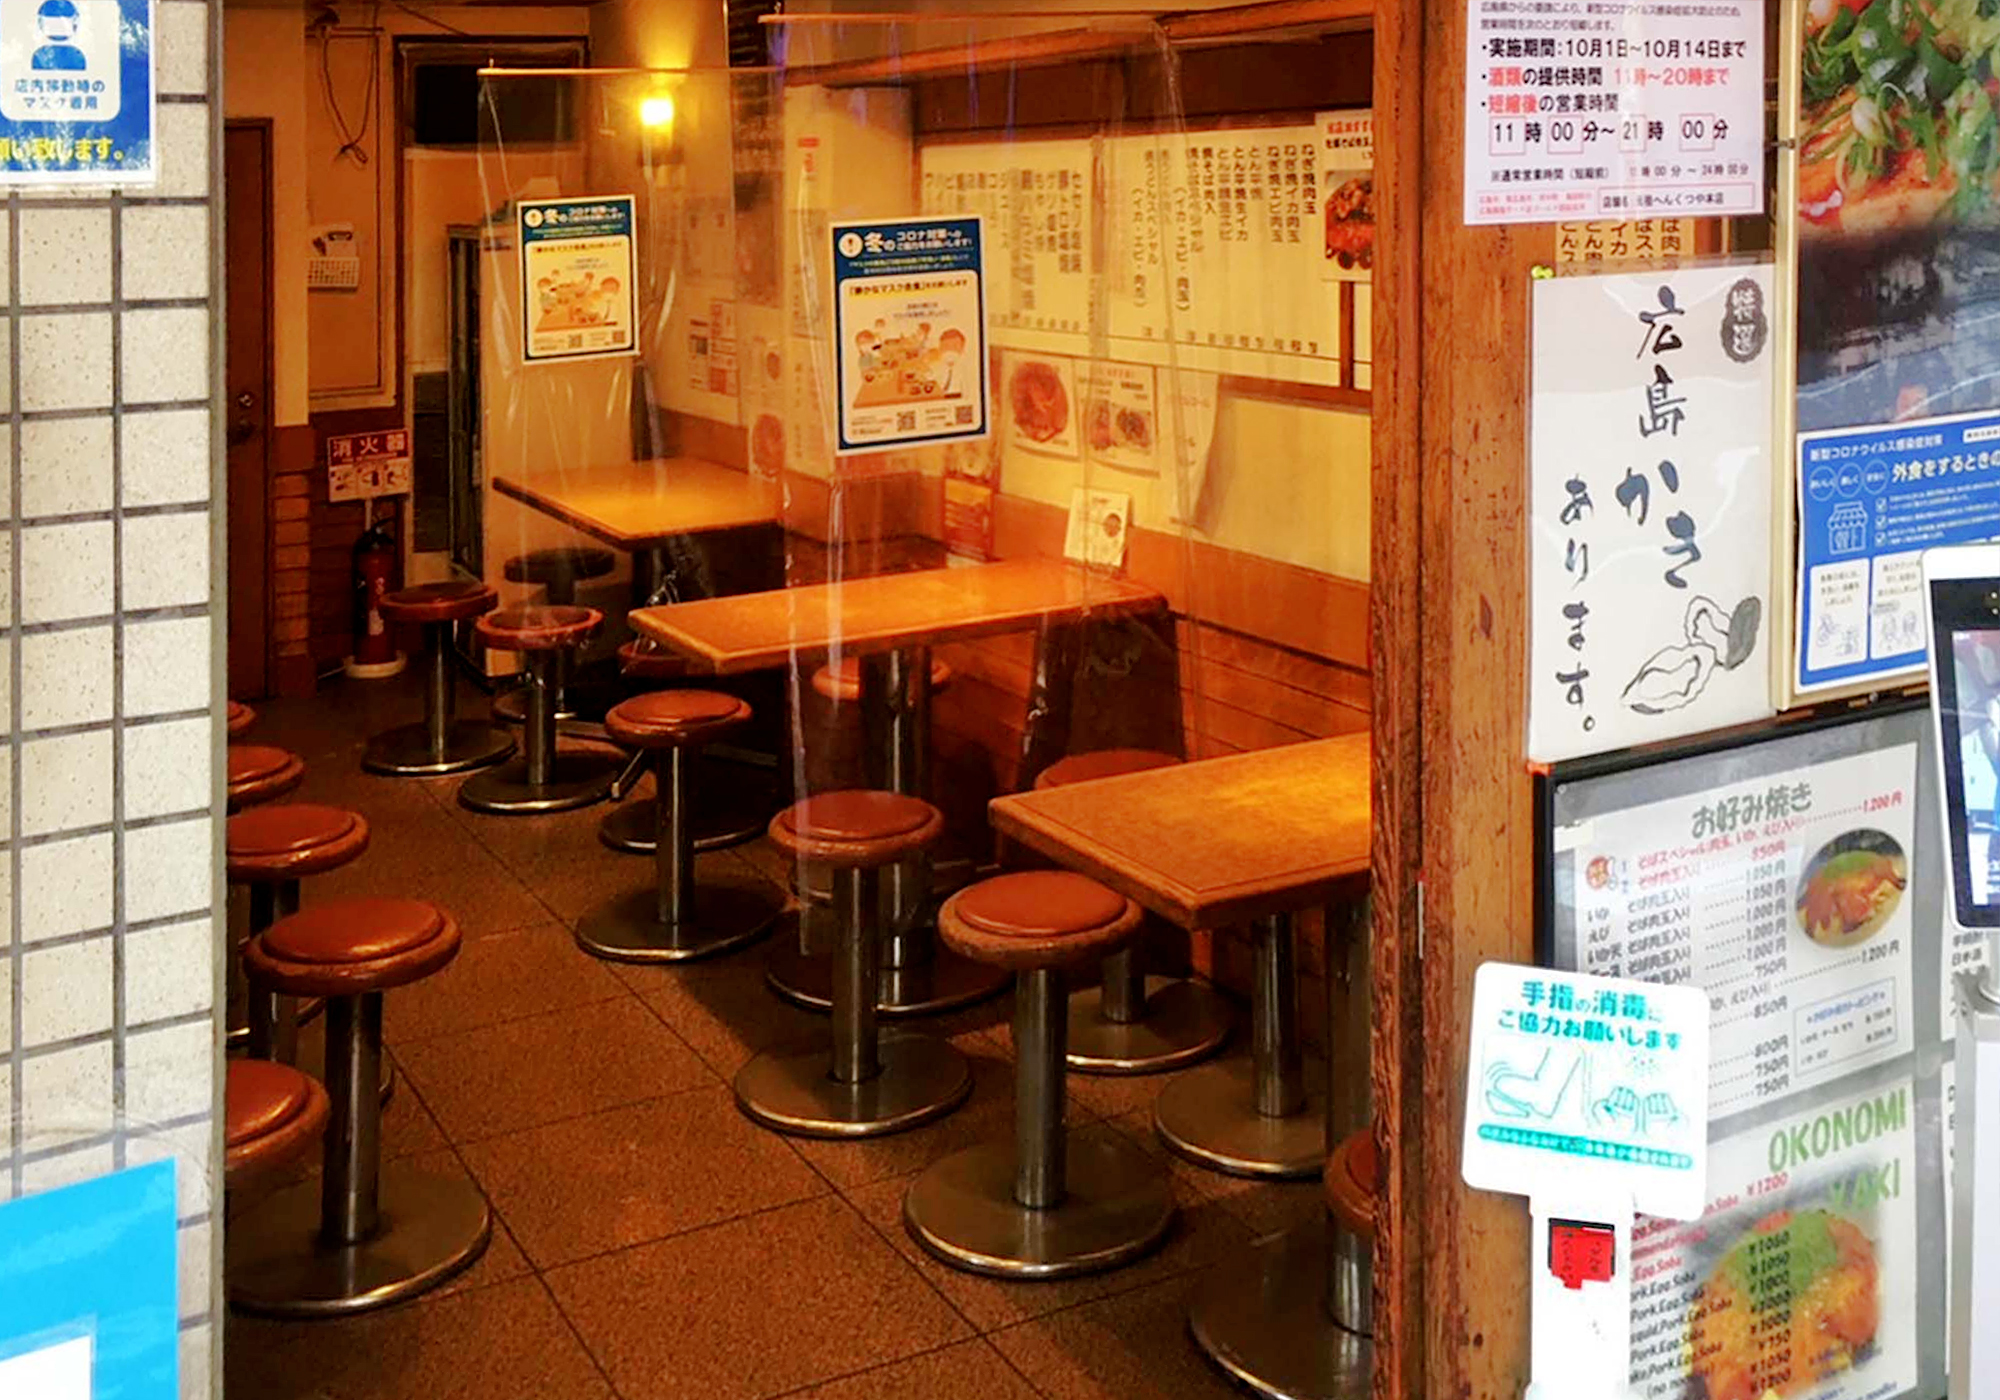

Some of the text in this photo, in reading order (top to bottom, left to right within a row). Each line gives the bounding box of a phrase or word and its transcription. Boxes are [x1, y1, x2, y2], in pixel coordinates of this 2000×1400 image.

[24, 96, 98, 110] マスク着用
[1615, 284, 1702, 590] 広島かき
[1556, 472, 1597, 732] あります。
[1691, 781, 1813, 839] お好み焼き
[1768, 1087, 1907, 1173] OKONOMI
